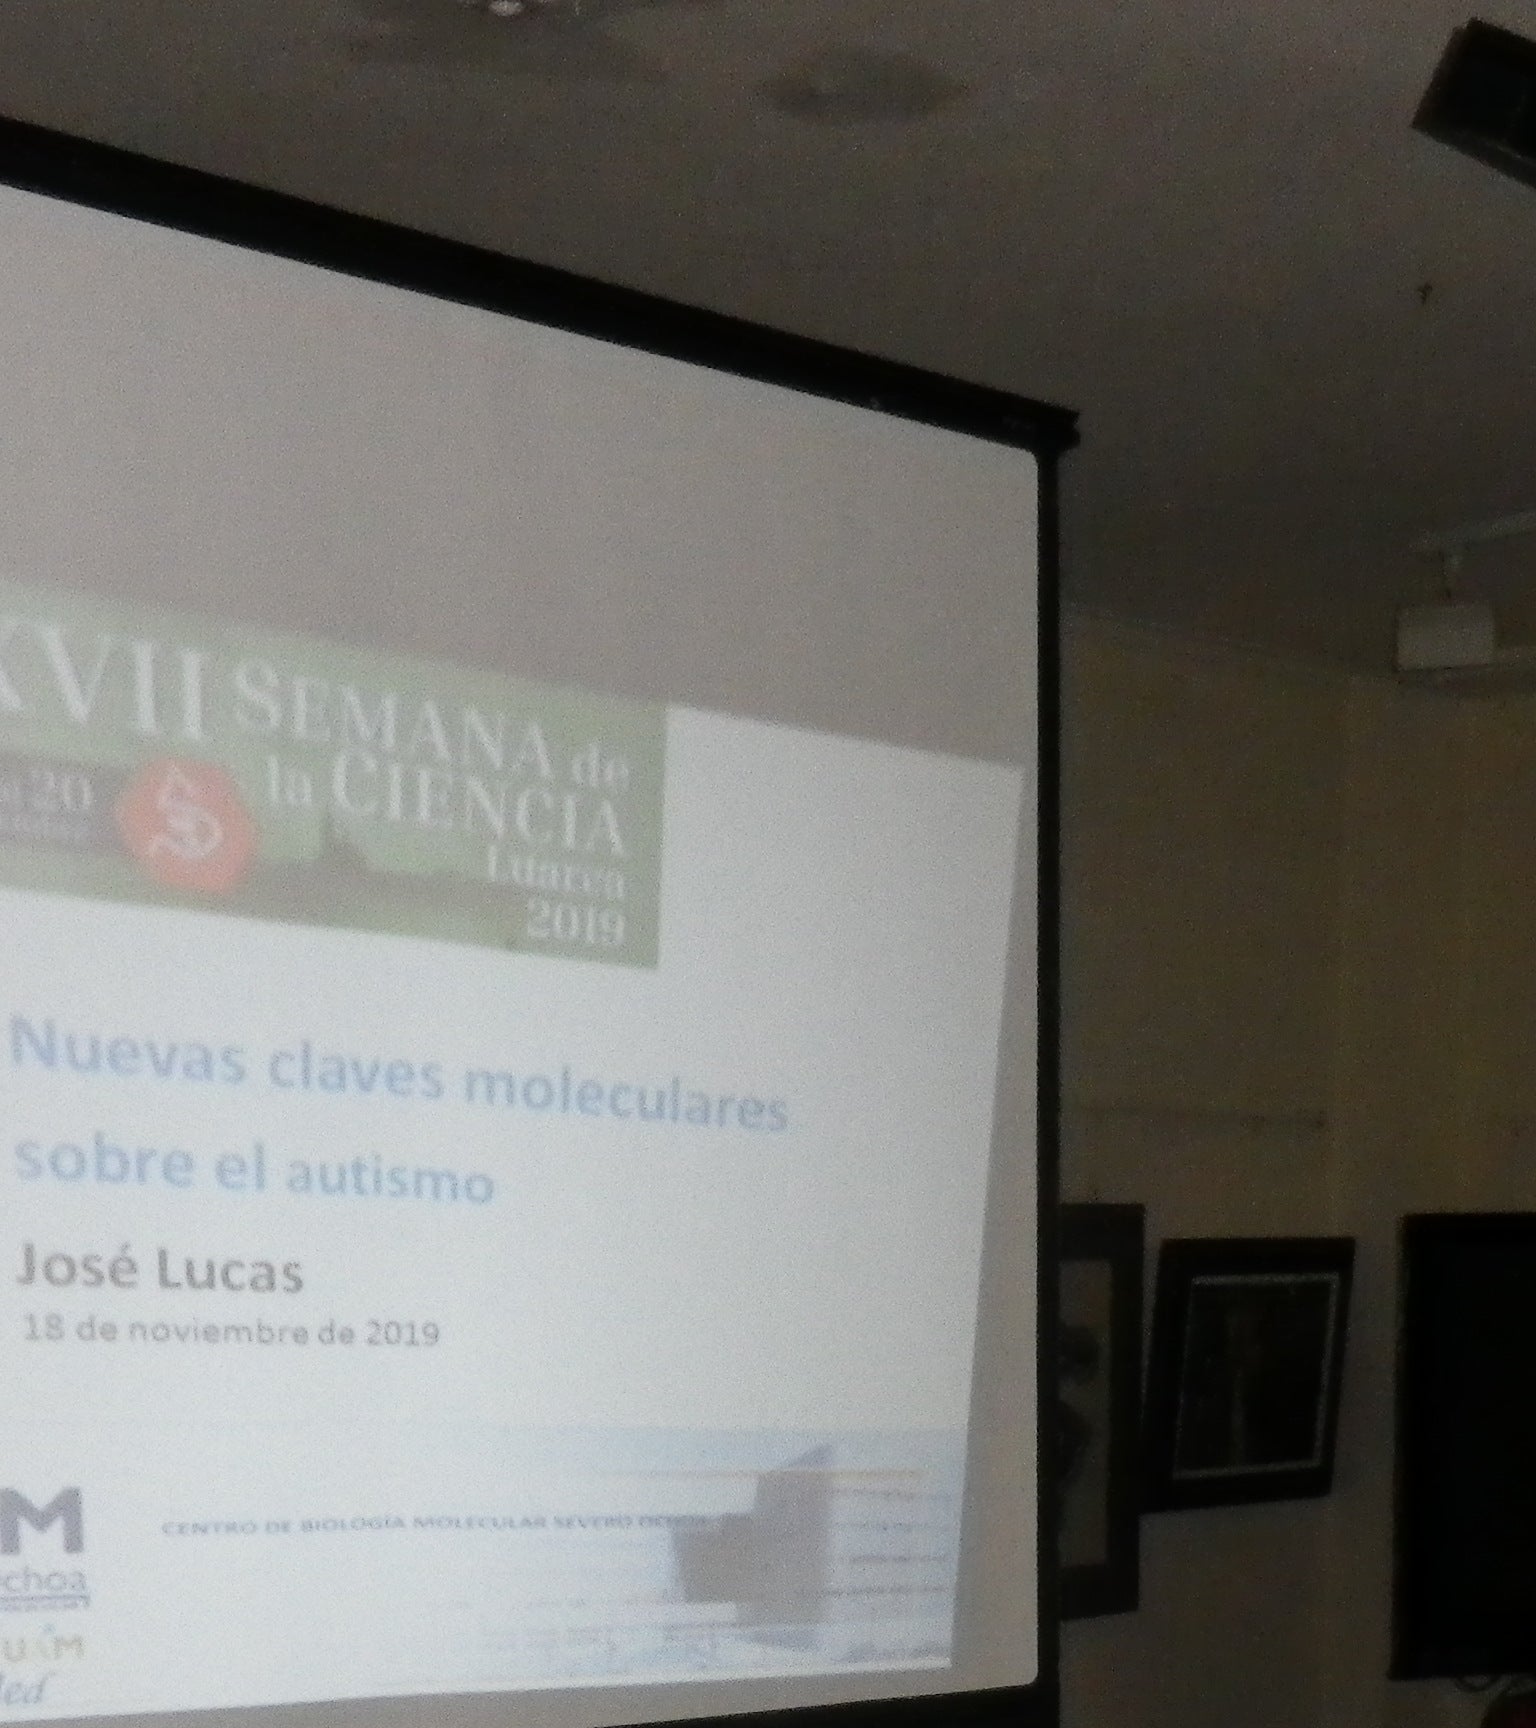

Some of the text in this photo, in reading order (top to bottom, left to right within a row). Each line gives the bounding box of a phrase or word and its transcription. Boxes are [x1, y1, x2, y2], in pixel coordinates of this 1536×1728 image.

[233, 664, 631, 793] SEMANA de
[29, 768, 93, 812] 20
[269, 752, 629, 858] la CIENCIA
[526, 897, 626, 947] 2019
[8, 1014, 789, 1134] Nuevas claves moleculares
[14, 1131, 495, 1206] sobre el autismo
[16, 1242, 305, 1295] José Lucas
[23, 1312, 442, 1348] 18 de noviembre de 2019
[160, 1519, 258, 1538] CENTRO
[263, 1519, 292, 1536] DE
[411, 1513, 549, 1533] MOLECULAR
